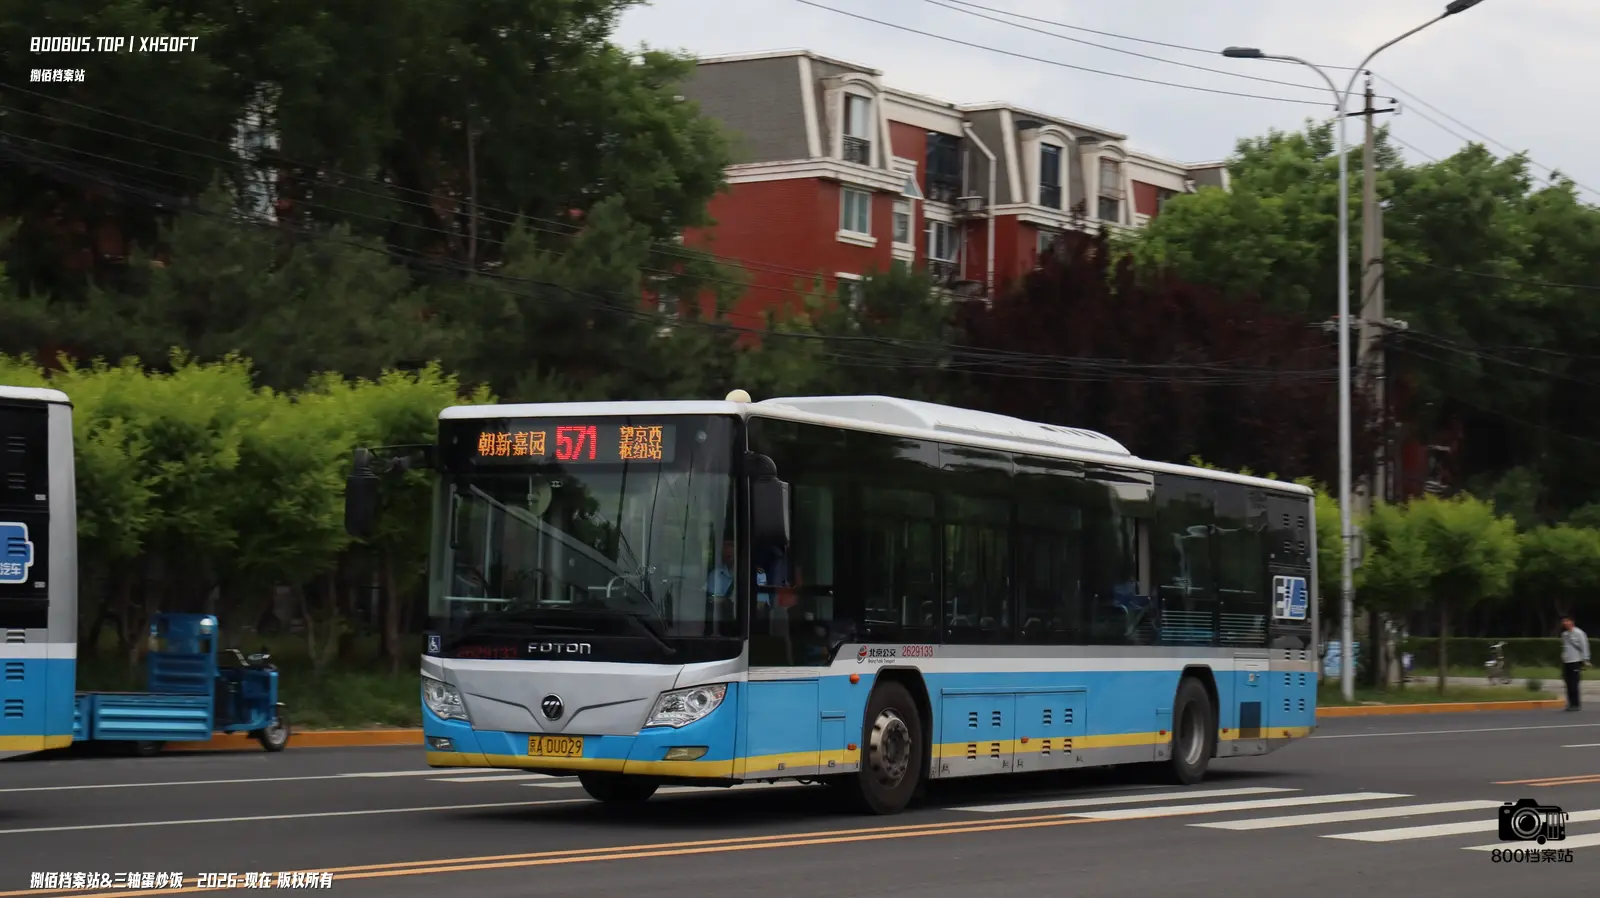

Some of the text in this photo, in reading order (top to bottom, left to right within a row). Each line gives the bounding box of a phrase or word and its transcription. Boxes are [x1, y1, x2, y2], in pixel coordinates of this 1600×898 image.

[555, 425, 597, 460] 571
[619, 425, 664, 443] 望京西
[478, 430, 547, 457] 朝新嘉园
[619, 442, 663, 460] 枢纽站
[528, 643, 591, 654] FOTON
[869, 648, 896, 657] 北京公交
[902, 645, 934, 657] 2629133
